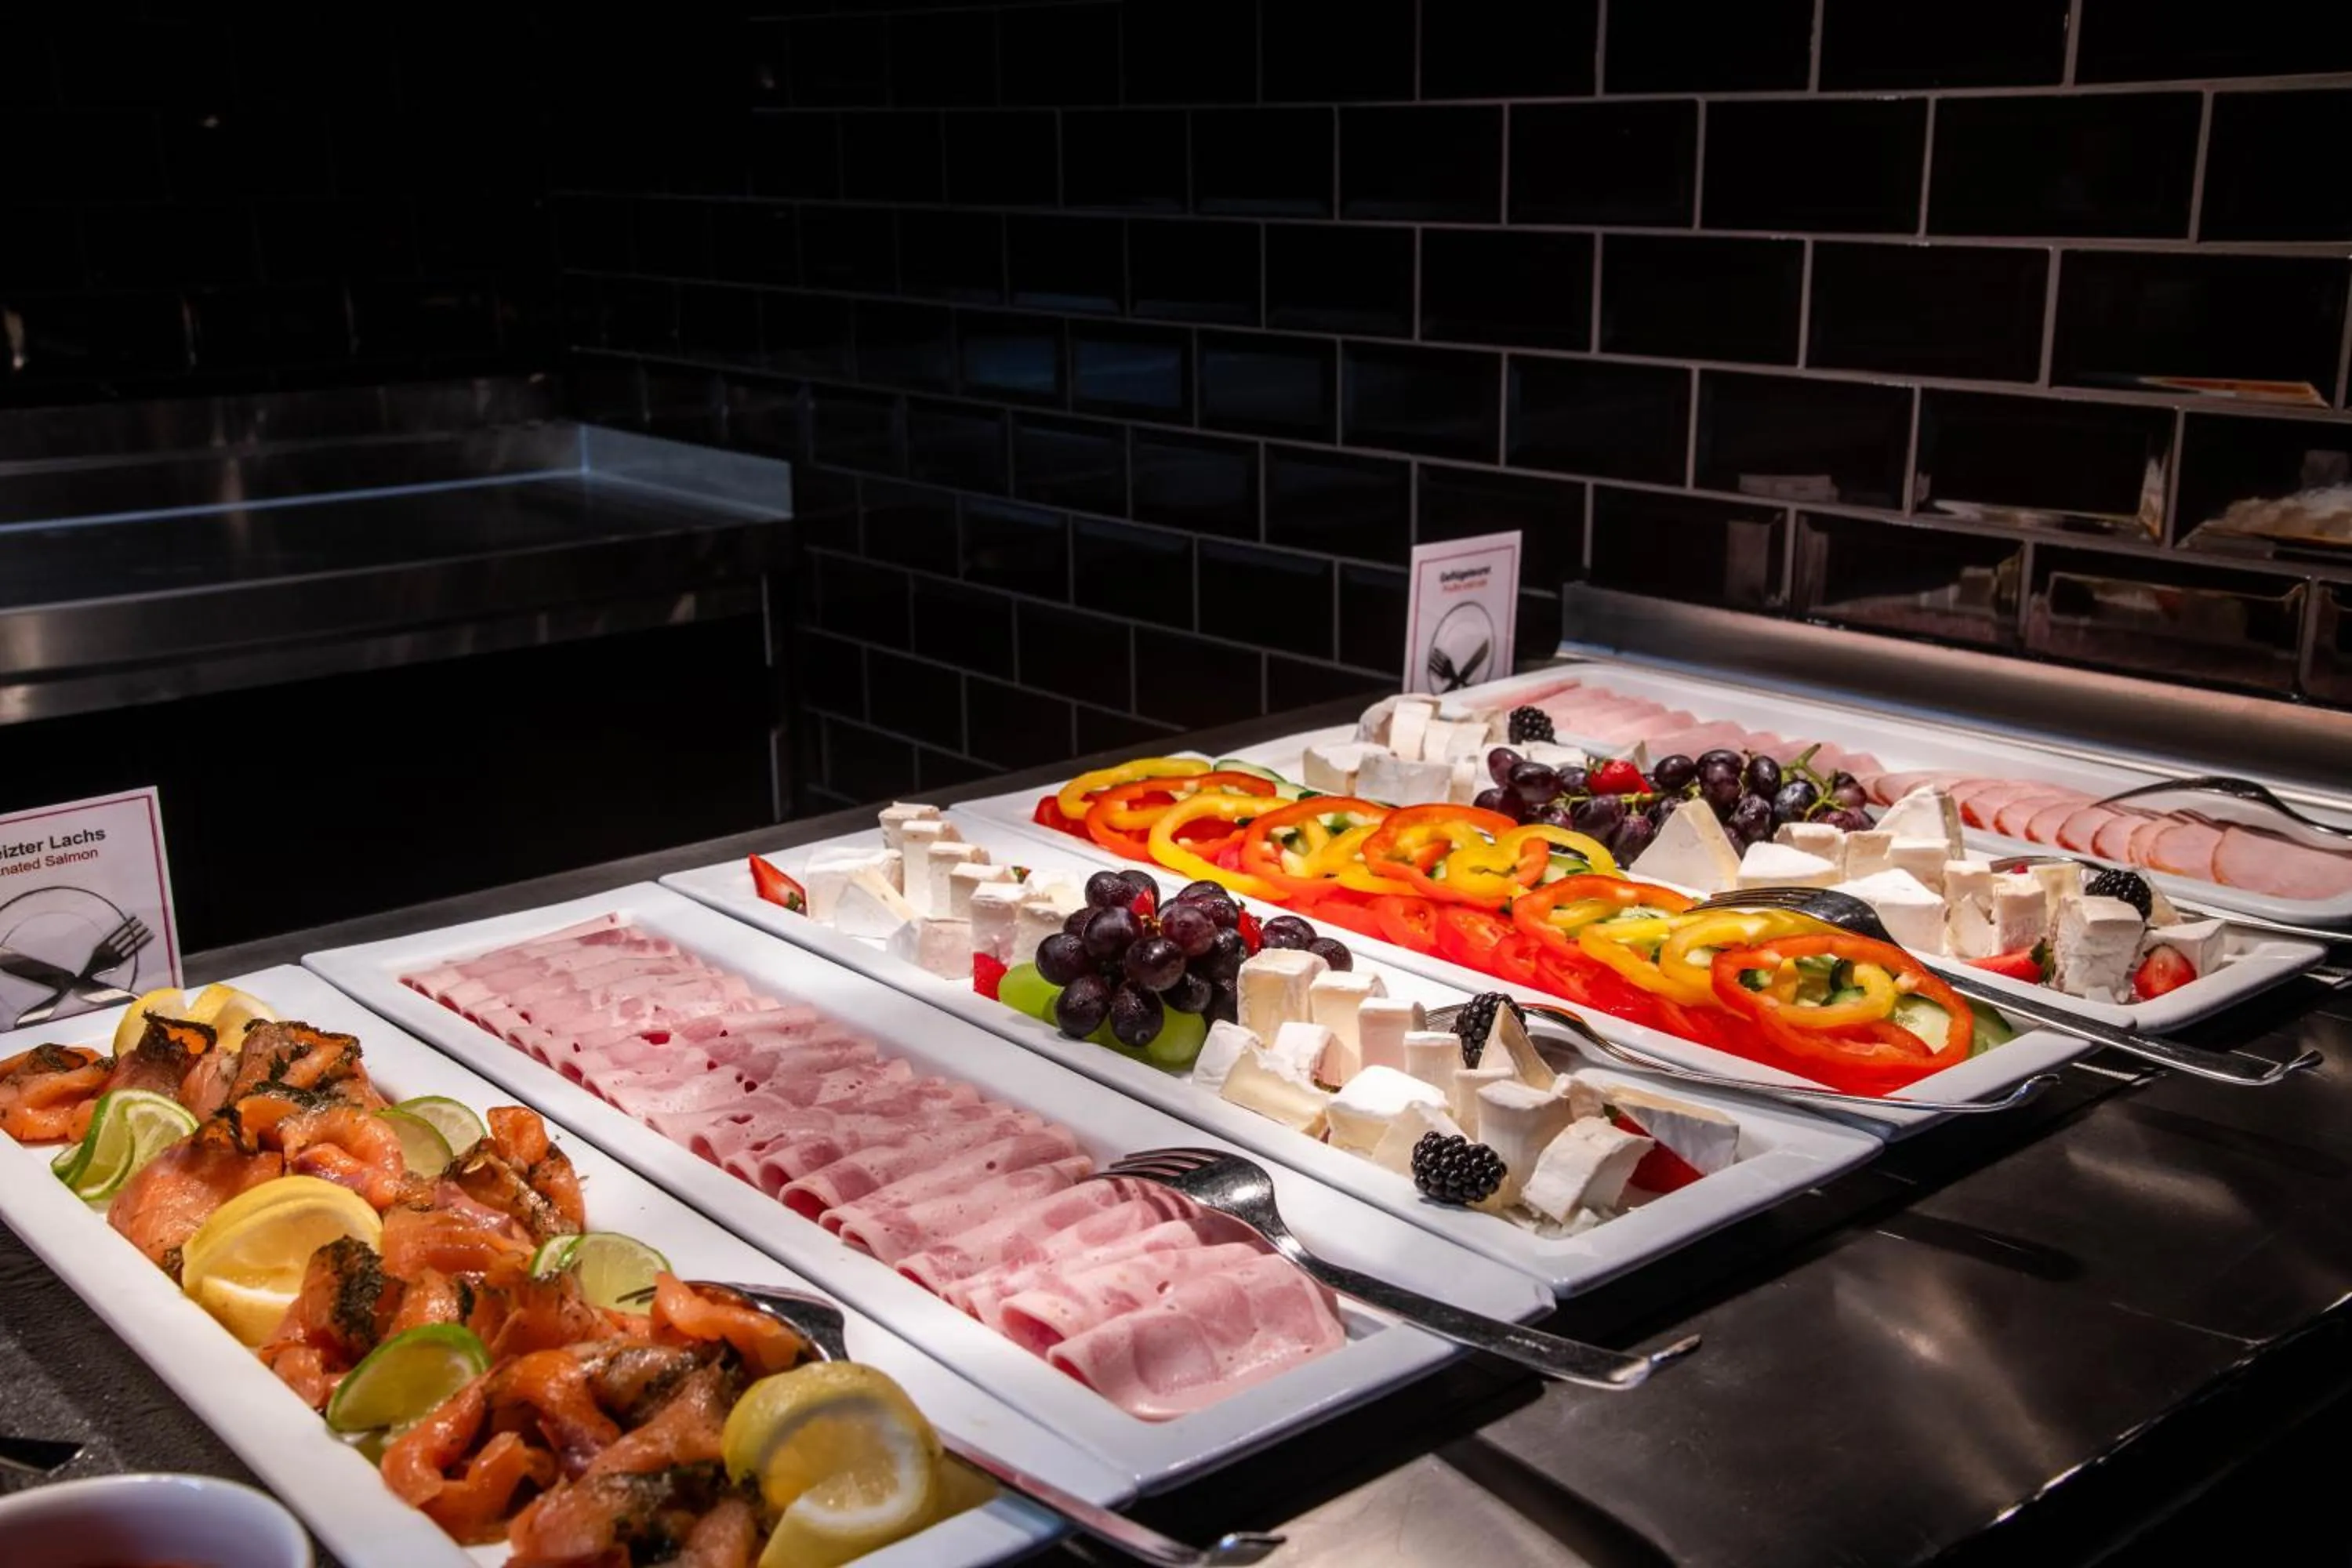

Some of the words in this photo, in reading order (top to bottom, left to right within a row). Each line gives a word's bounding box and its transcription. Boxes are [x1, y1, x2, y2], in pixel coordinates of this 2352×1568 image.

[0, 840, 45, 860] izter
[49, 829, 106, 849] Lachs
[45, 849, 99, 867] Salmon
